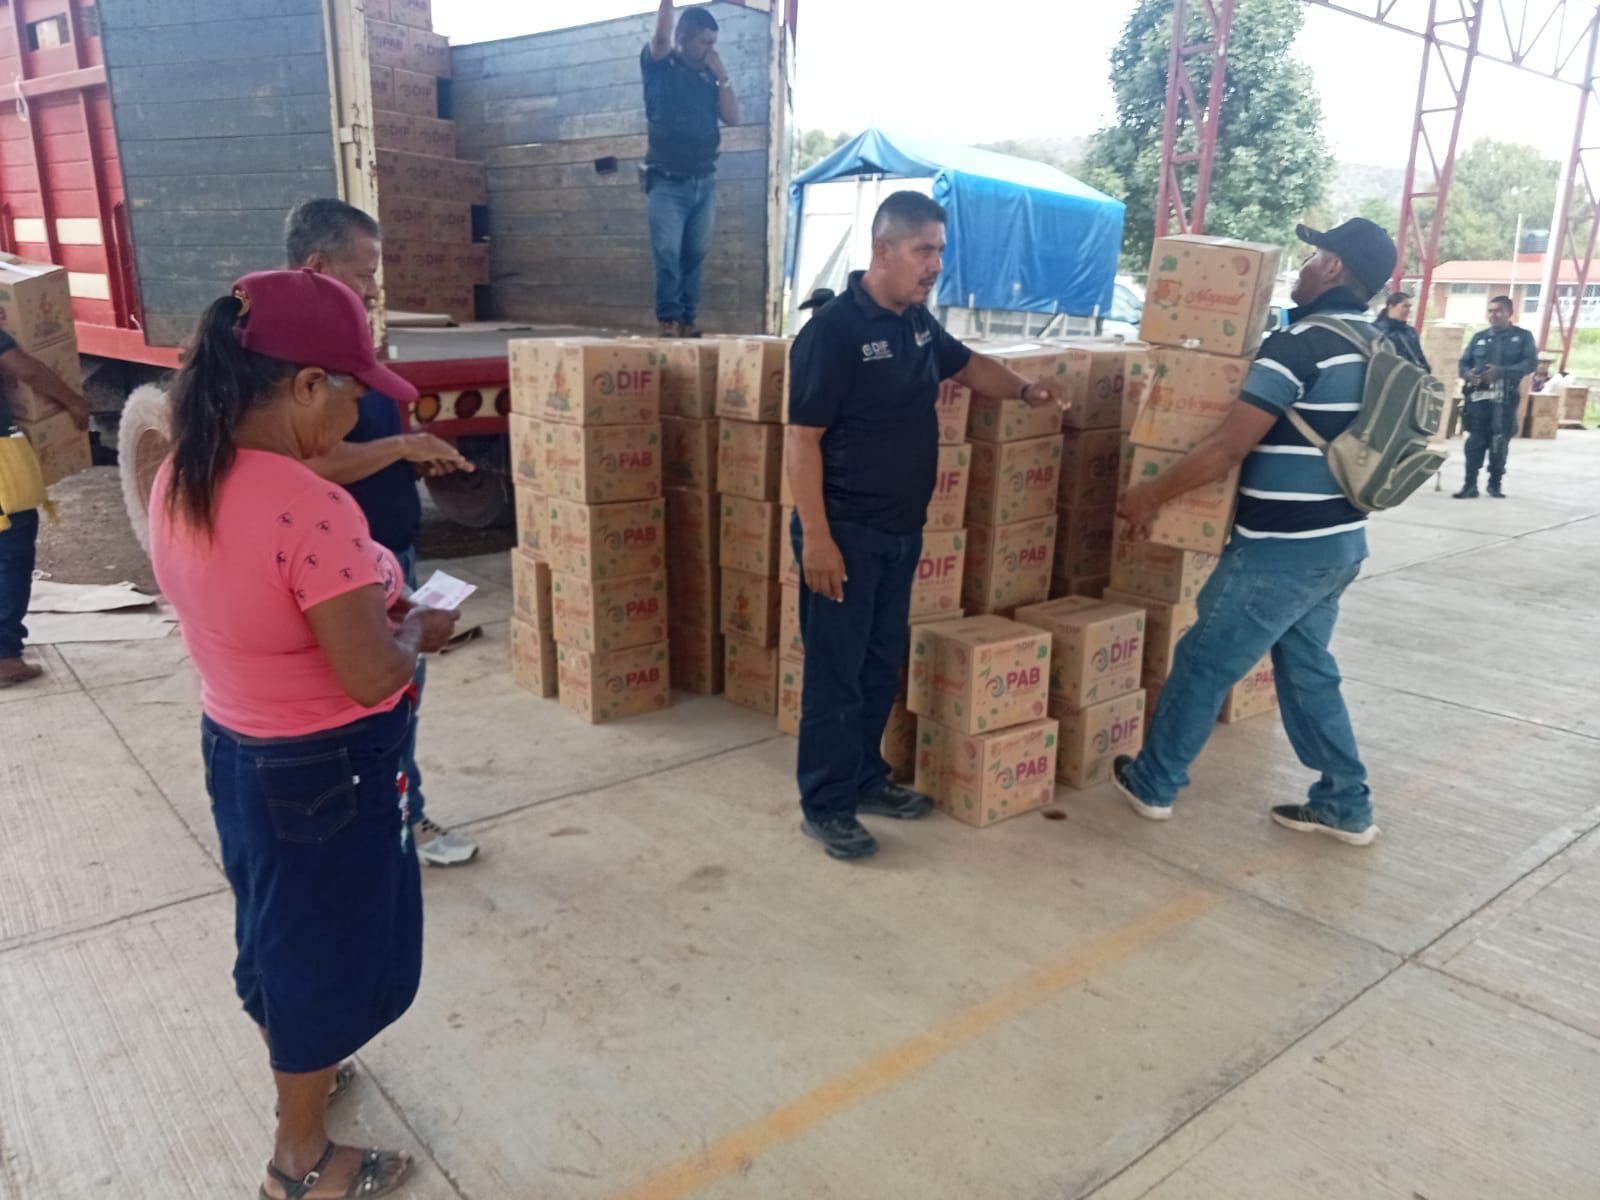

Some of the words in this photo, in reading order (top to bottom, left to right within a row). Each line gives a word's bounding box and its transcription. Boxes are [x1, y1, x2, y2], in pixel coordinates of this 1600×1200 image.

[617, 370, 652, 391] DIF
[941, 382, 963, 406] IF
[619, 452, 653, 472] PAB
[939, 471, 961, 494] IF
[1024, 466, 1054, 486] PAB
[623, 526, 657, 546] PAB
[1018, 545, 1047, 563] PAB
[918, 555, 957, 580] DIF
[625, 597, 659, 617] PAB
[1110, 637, 1138, 663] DIF
[625, 667, 660, 688] PAB
[1006, 667, 1040, 690] PAB
[1110, 716, 1139, 744] DIF
[1015, 755, 1048, 782] PAB
